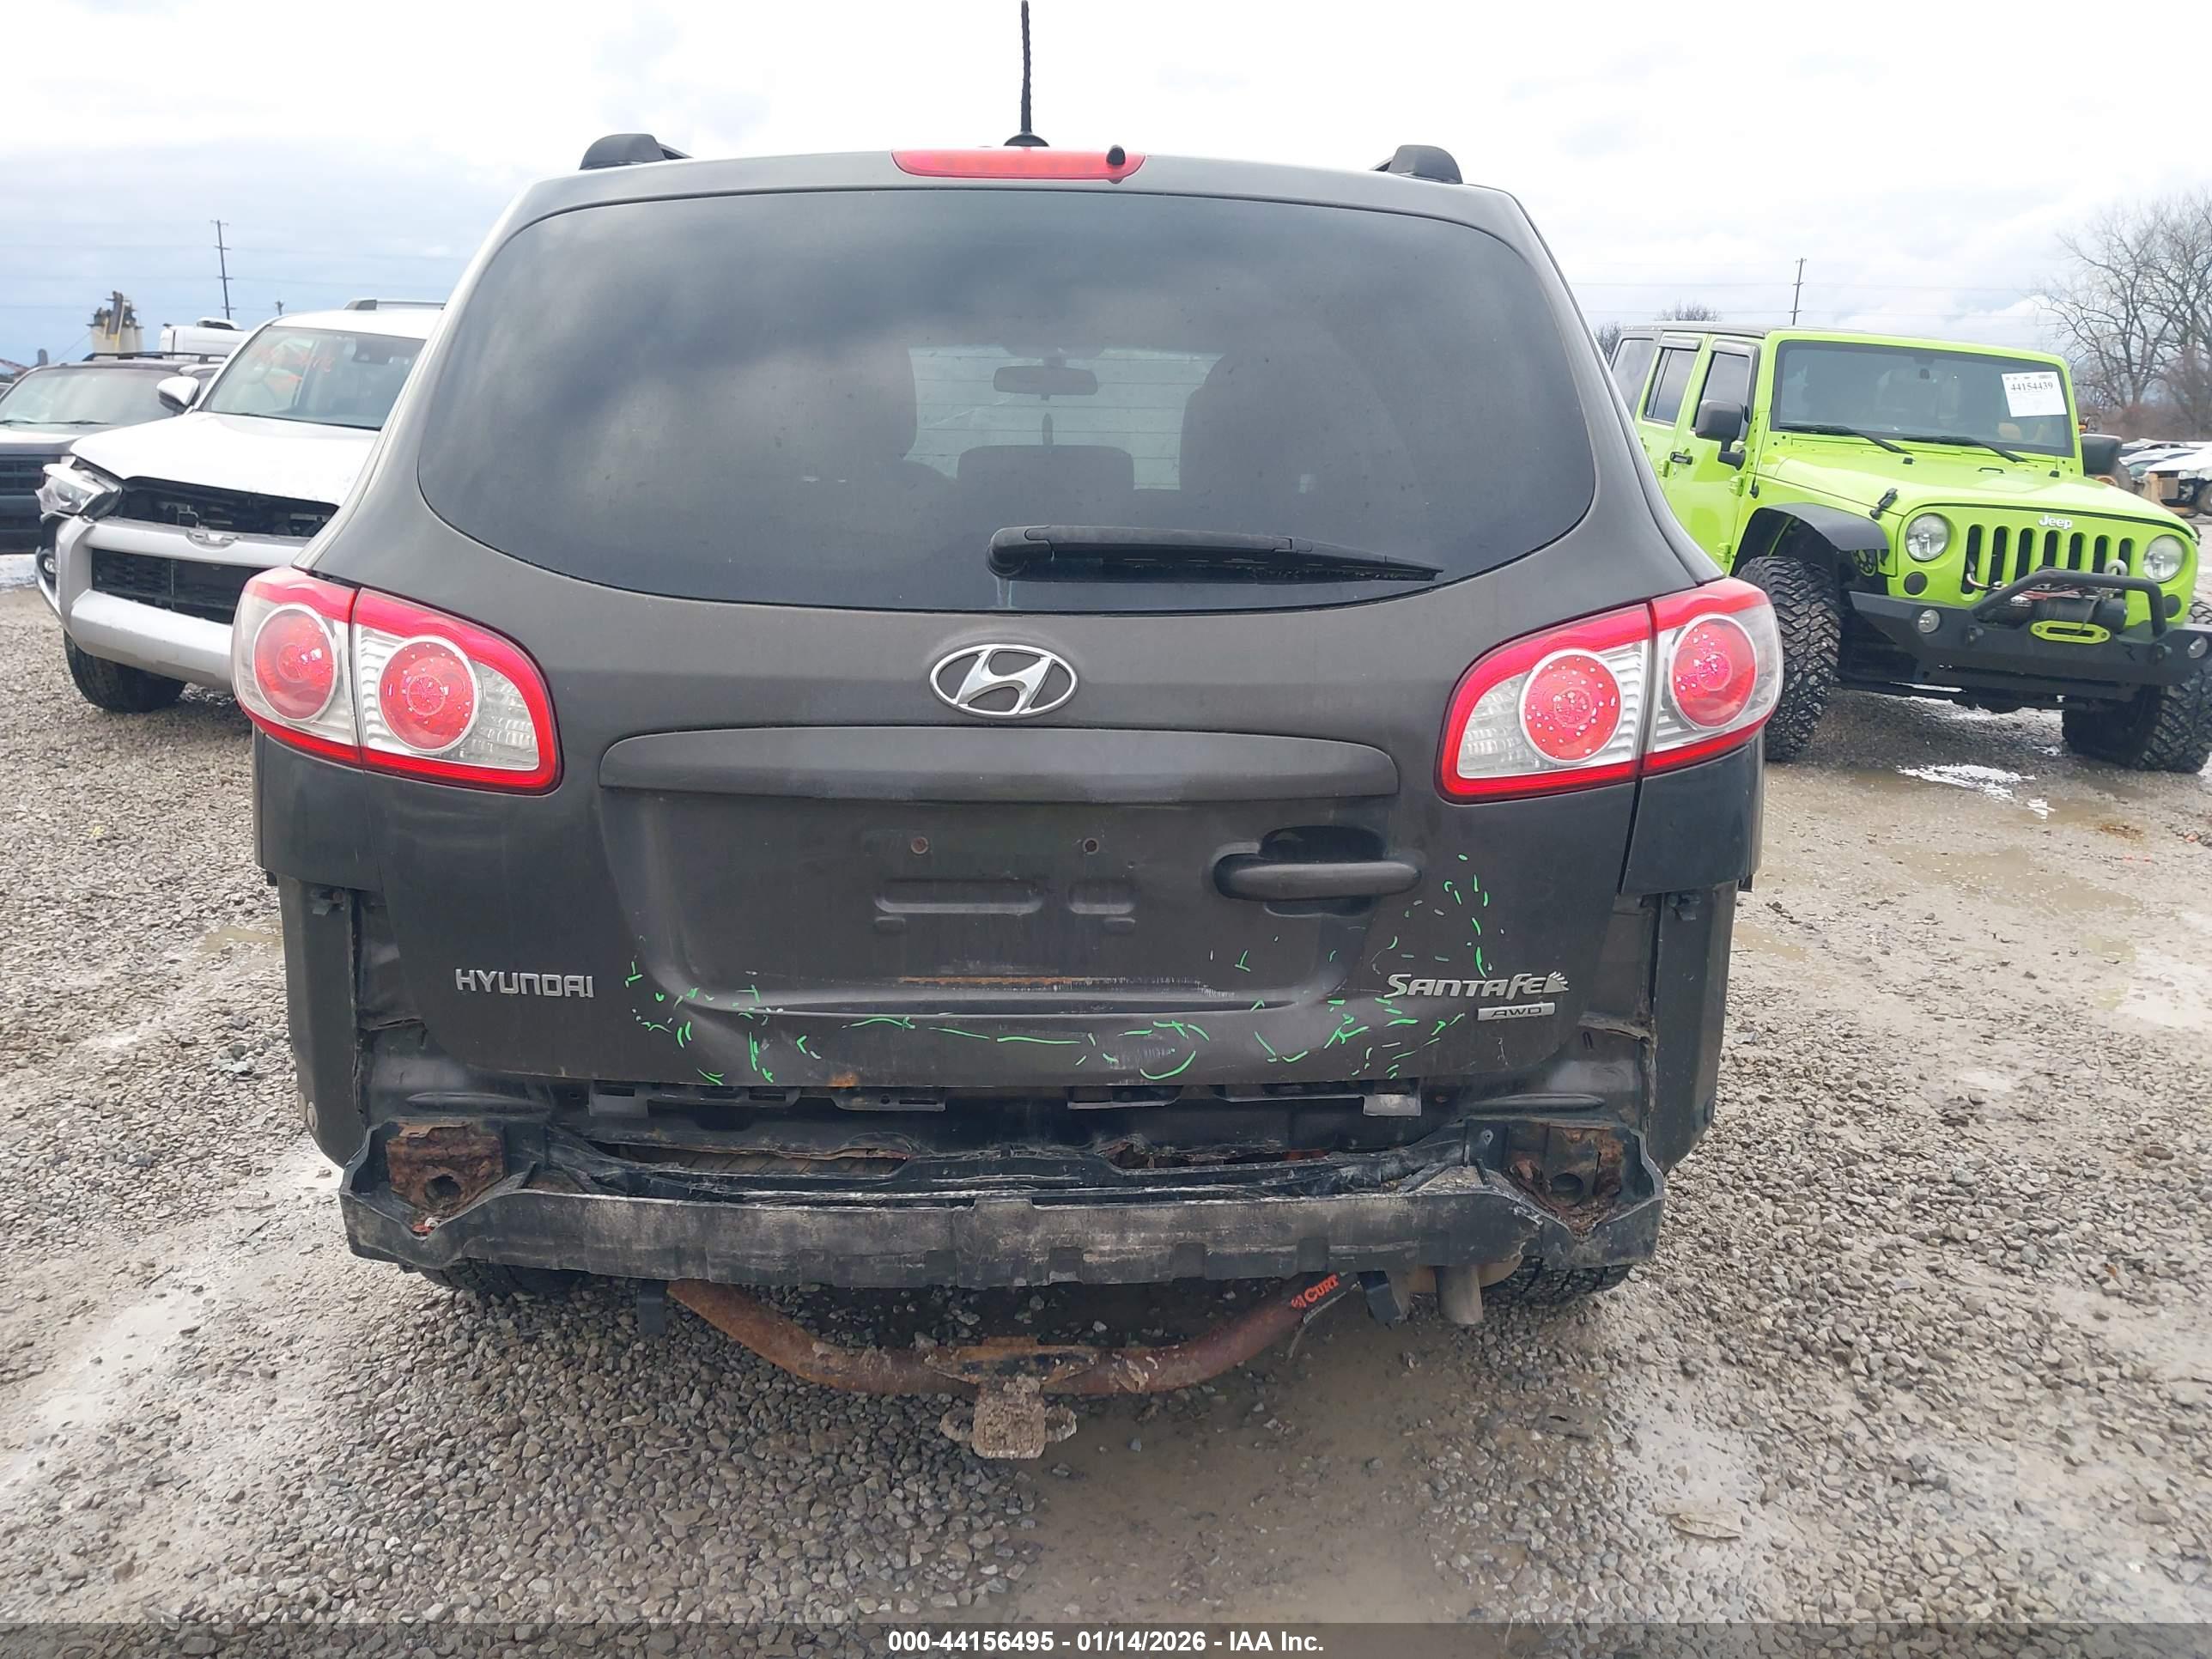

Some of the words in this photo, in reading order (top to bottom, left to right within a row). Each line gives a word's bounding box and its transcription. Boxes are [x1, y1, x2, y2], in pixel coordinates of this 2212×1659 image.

[2011, 382, 2054, 392] 44154439
[2039, 514, 2074, 531] Jeep
[454, 968, 595, 999] HYUNDAI
[1491, 1006, 1542, 1018] AWD
